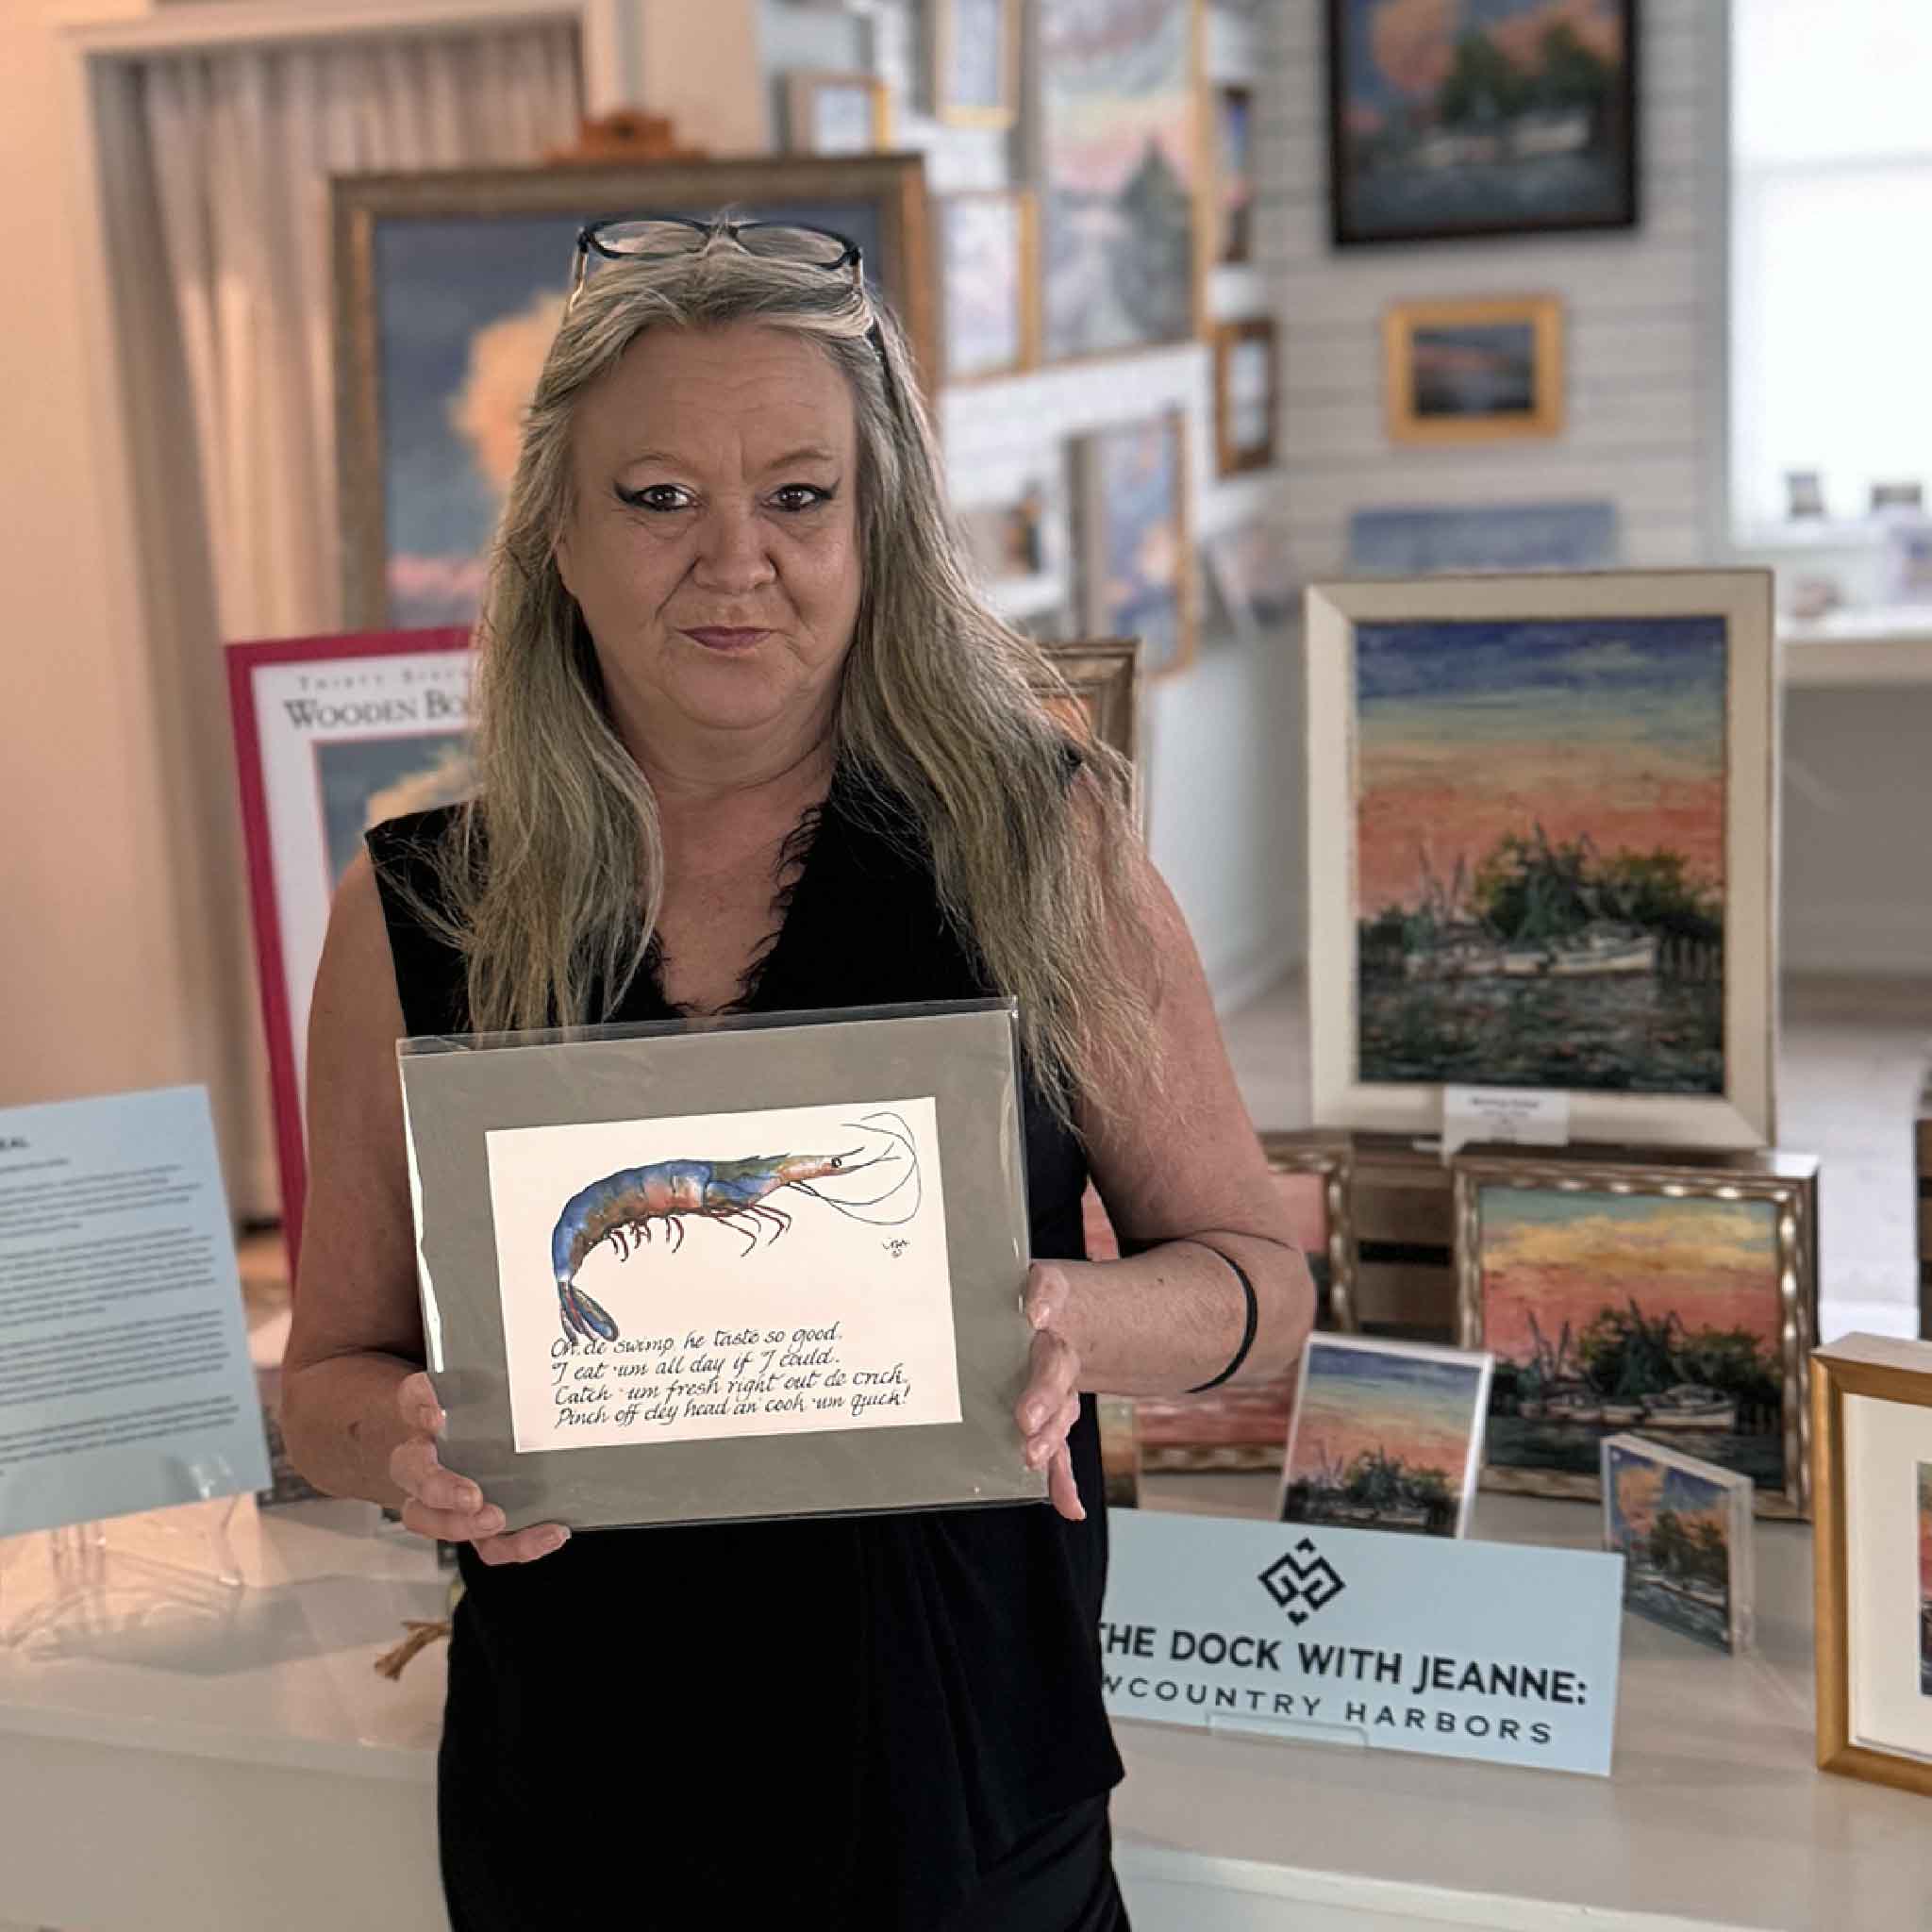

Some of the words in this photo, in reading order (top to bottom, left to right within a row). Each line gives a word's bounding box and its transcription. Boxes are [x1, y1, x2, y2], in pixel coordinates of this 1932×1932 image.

[684, 1329, 706, 1350] he
[714, 1328, 759, 1347] taste
[764, 1329, 786, 1344] so
[574, 1361, 609, 1380] eat
[656, 1355, 686, 1375] all
[691, 1352, 726, 1380] day
[733, 1350, 756, 1378] if
[555, 1384, 613, 1407] Catch
[665, 1376, 720, 1404] fresh
[727, 1373, 786, 1403] right
[784, 1369, 824, 1391] out
[824, 1368, 847, 1387] de
[555, 1405, 609, 1429] Pinch
[614, 1402, 642, 1427] off
[684, 1396, 730, 1418] head
[1170, 1629, 1283, 1672] DOCK
[1297, 1641, 1404, 1686] WITH
[1412, 1654, 1589, 1707] JEANNE:
[1345, 1700, 1554, 1744] HARBORS
